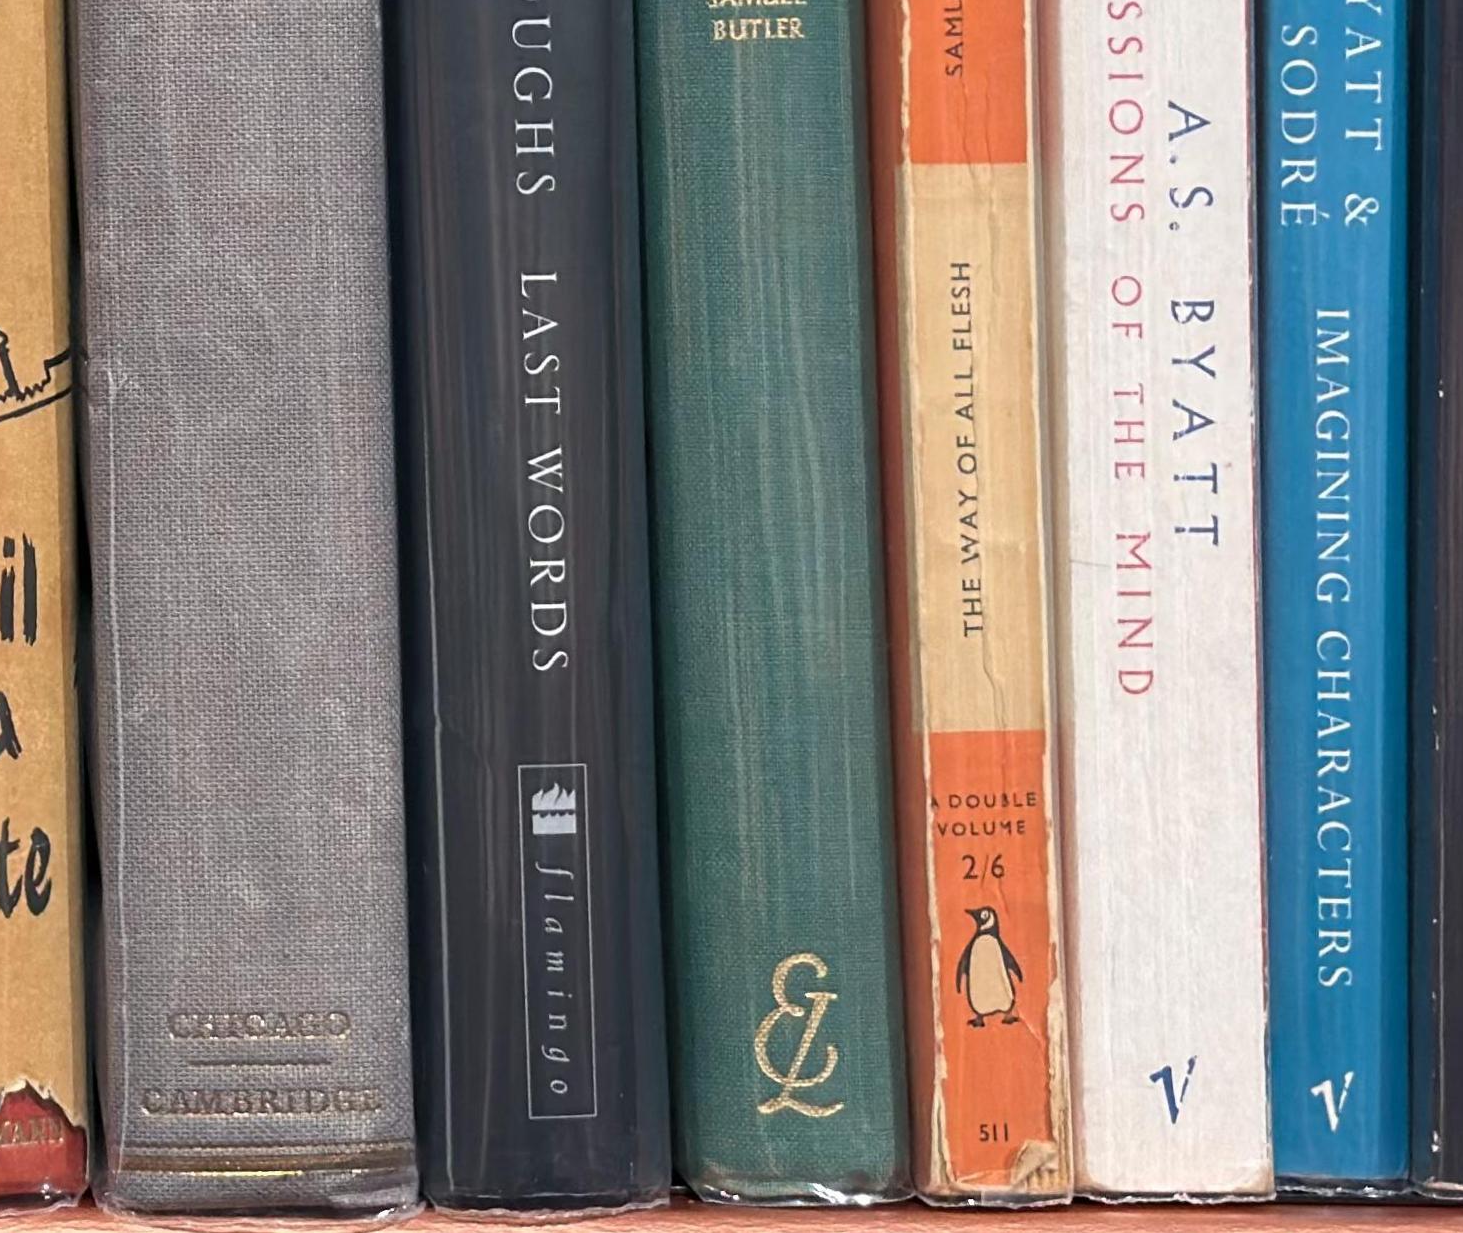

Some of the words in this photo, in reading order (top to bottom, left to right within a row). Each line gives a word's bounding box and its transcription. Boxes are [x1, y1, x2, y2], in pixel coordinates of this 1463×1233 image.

[711, 17, 806, 42] BUTLER
[1279, 23, 1331, 227] SODRÉ
[1344, 193, 1380, 226] &
[950, 261, 973, 352] FLESH
[1111, 275, 1144, 340] OF
[519, 271, 562, 416] LAST
[955, 371, 975, 422] ALL
[1170, 299, 1219, 547] BYATT
[956, 435, 978, 475] OF
[1113, 382, 1146, 481] THE
[1314, 307, 1352, 605] IMAGINING
[524, 446, 569, 673] WORDS
[957, 490, 981, 566] WAY
[963, 576, 984, 638] THE
[1114, 531, 1155, 696] MIND
[937, 819, 1027, 837] VOLUME
[948, 791, 1037, 809] DOUBLE
[1314, 629, 1354, 989] CHARACTERS
[962, 854, 1006, 881] 2/6
[535, 861, 575, 1095] flamingo
[169, 1012, 351, 1040] CHICAGO
[141, 1088, 382, 1117] CAMBRIDGE
[979, 1122, 1010, 1143] 511
